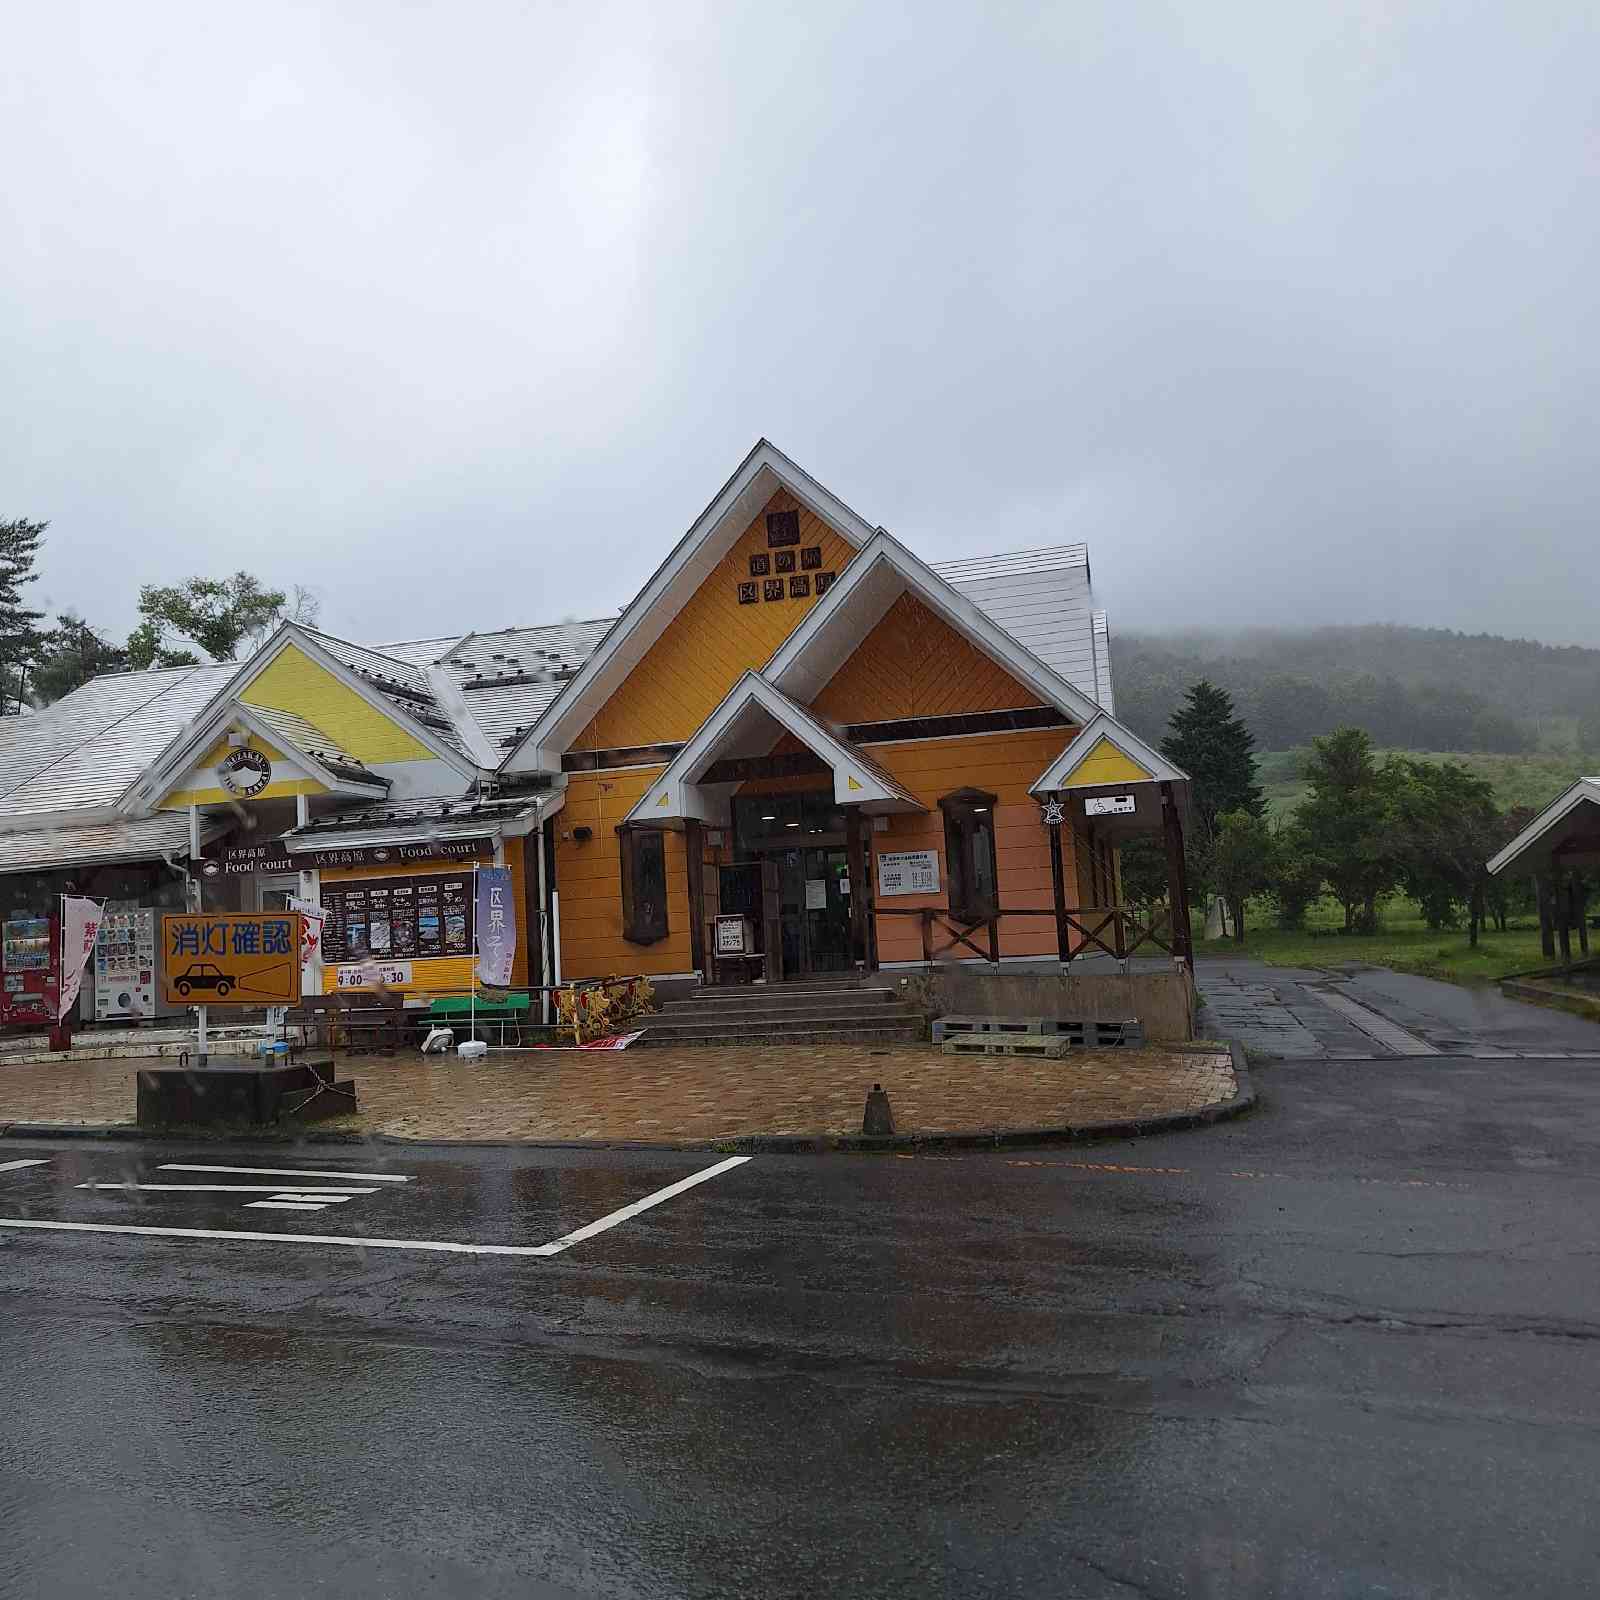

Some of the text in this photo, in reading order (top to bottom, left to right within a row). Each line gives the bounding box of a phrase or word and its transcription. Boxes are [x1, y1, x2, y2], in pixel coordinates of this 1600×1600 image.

[740, 573, 834, 602] 区界高原
[399, 842, 478, 858] Food court
[225, 859, 293, 873] Food court
[171, 921, 292, 956] 消灯確認
